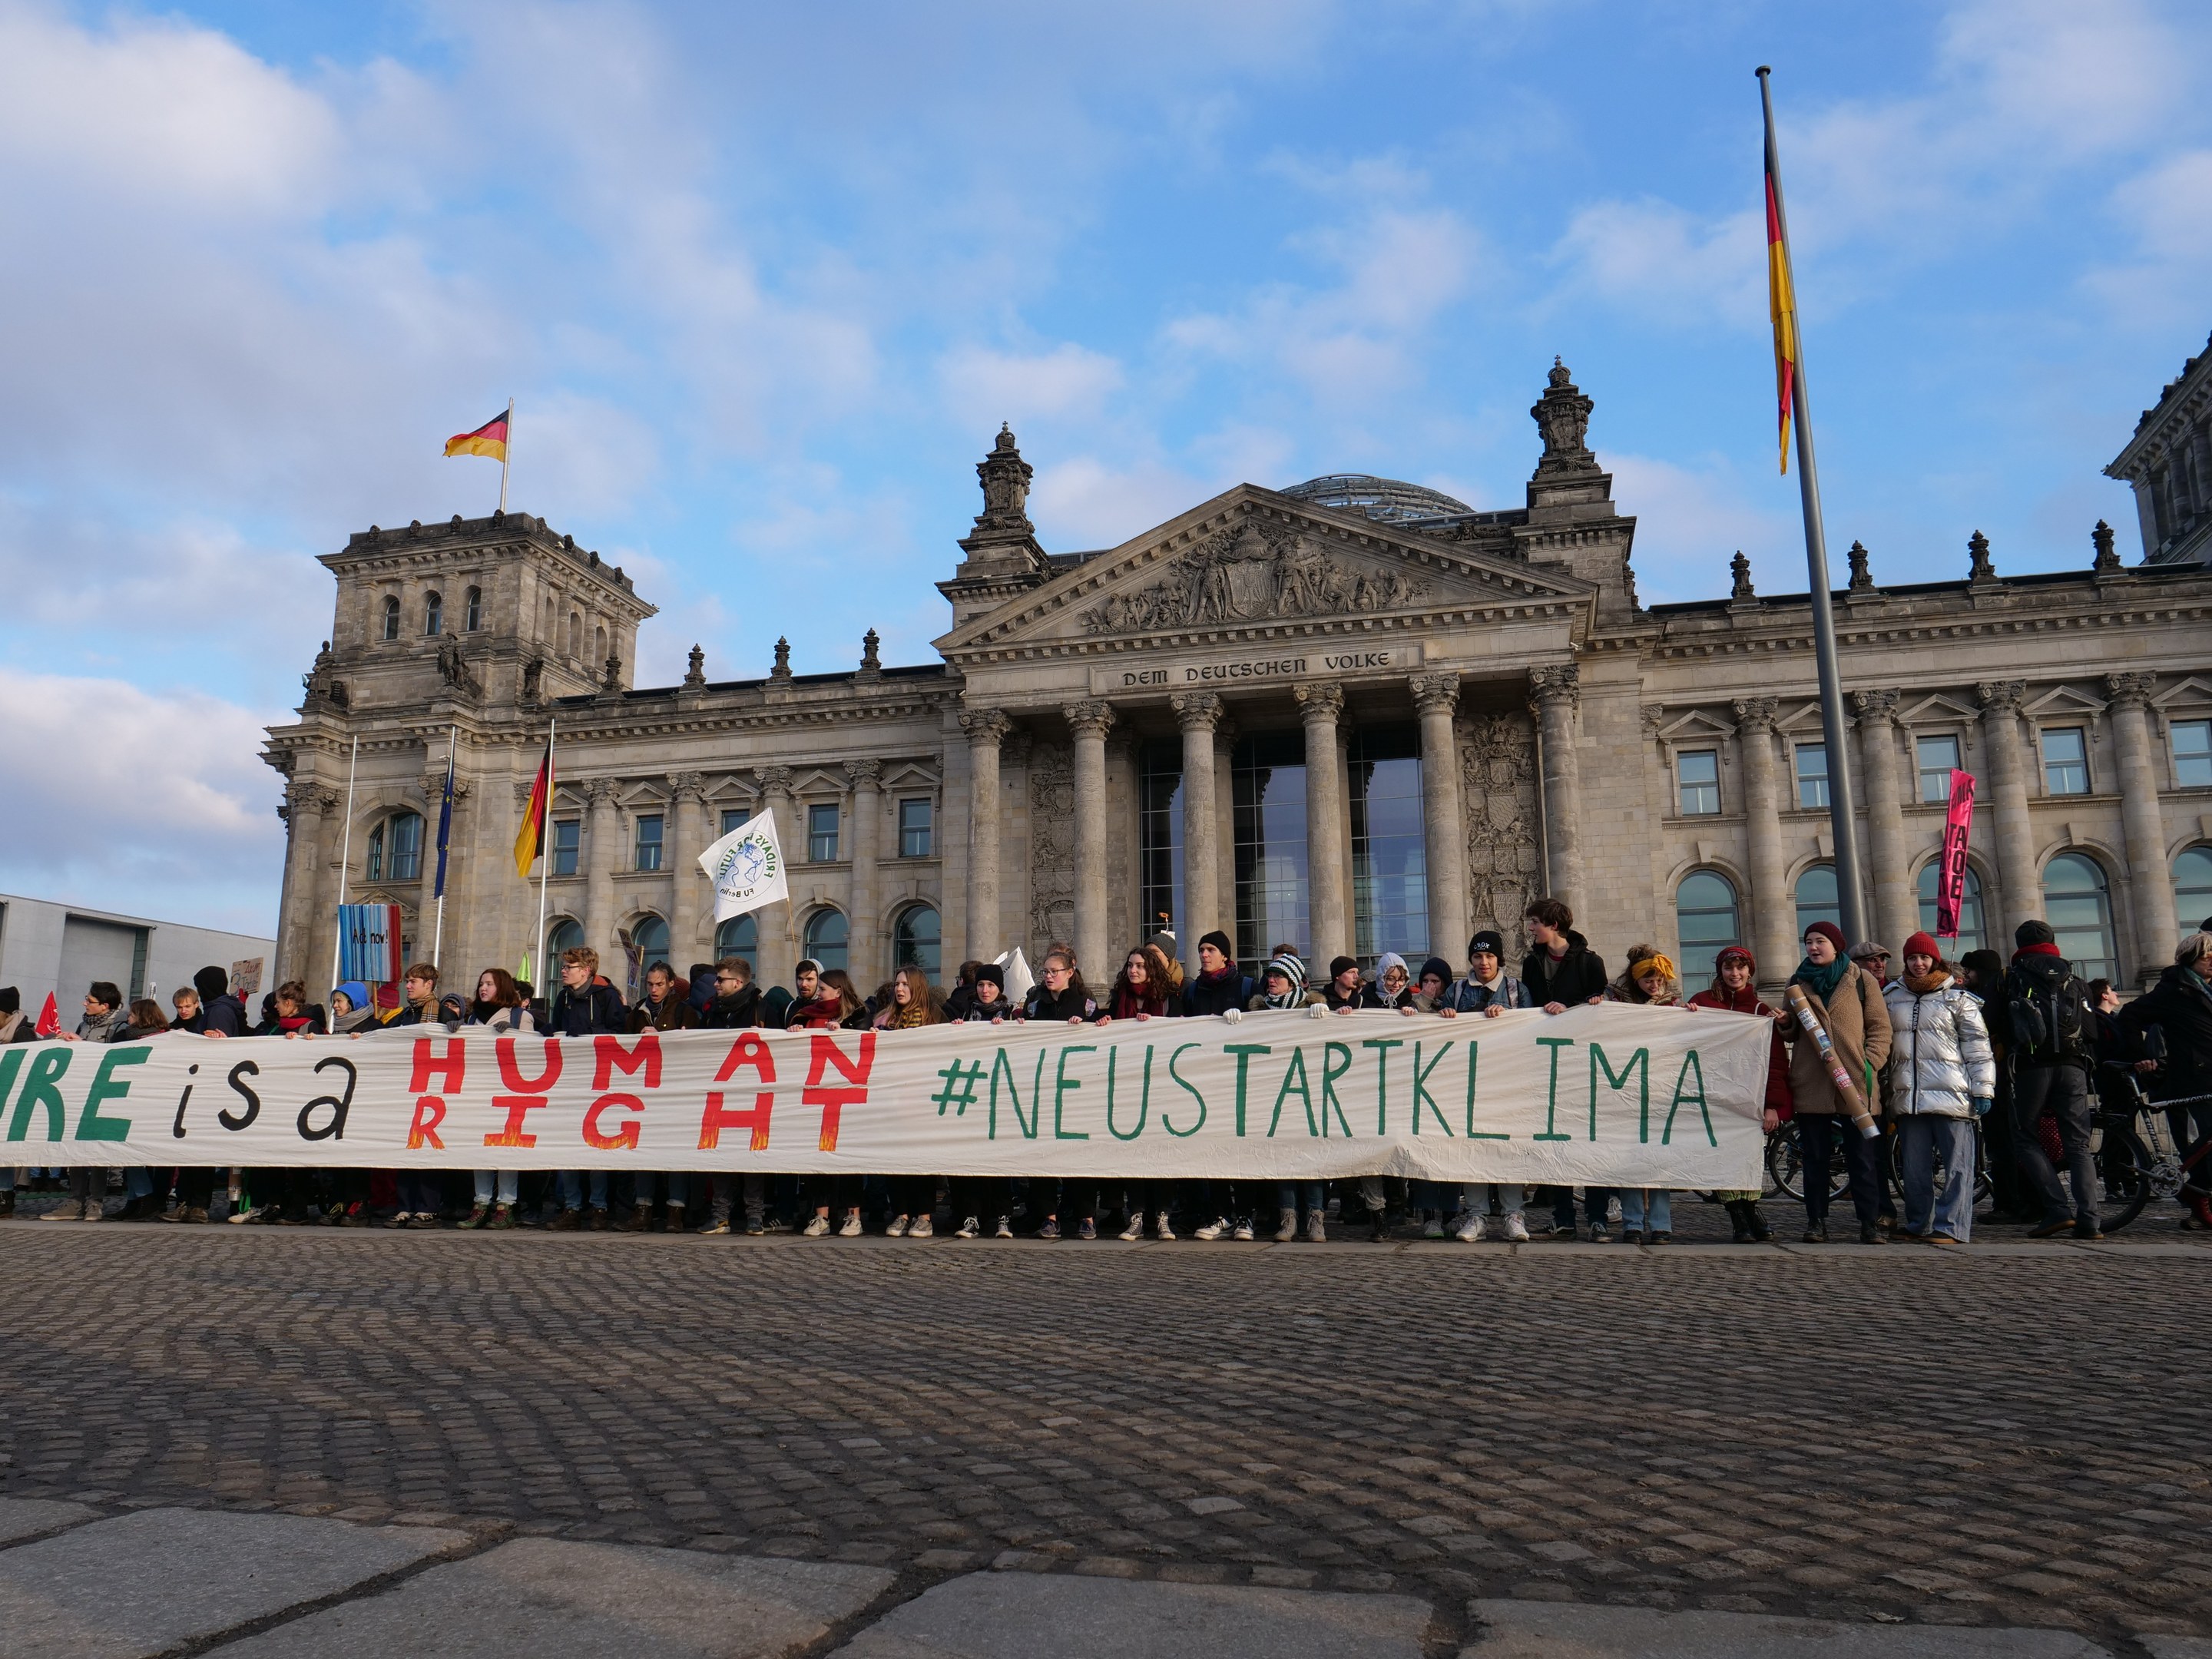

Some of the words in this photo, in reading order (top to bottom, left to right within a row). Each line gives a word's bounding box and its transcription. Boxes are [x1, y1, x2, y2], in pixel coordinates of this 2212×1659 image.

[1123, 670, 1168, 687] DEM
[1185, 658, 1306, 682] DEUTSCHEN
[1325, 651, 1390, 670] VOLKE
[353, 928, 367, 944] Act
[370, 929, 389, 944] now!
[409, 1031, 877, 1094] HUMAN
[931, 1037, 1718, 1147] #NEUSTARTKLIMA
[173, 1059, 261, 1139] is
[296, 1056, 358, 1141] a
[406, 1088, 869, 1152] RIGHT
